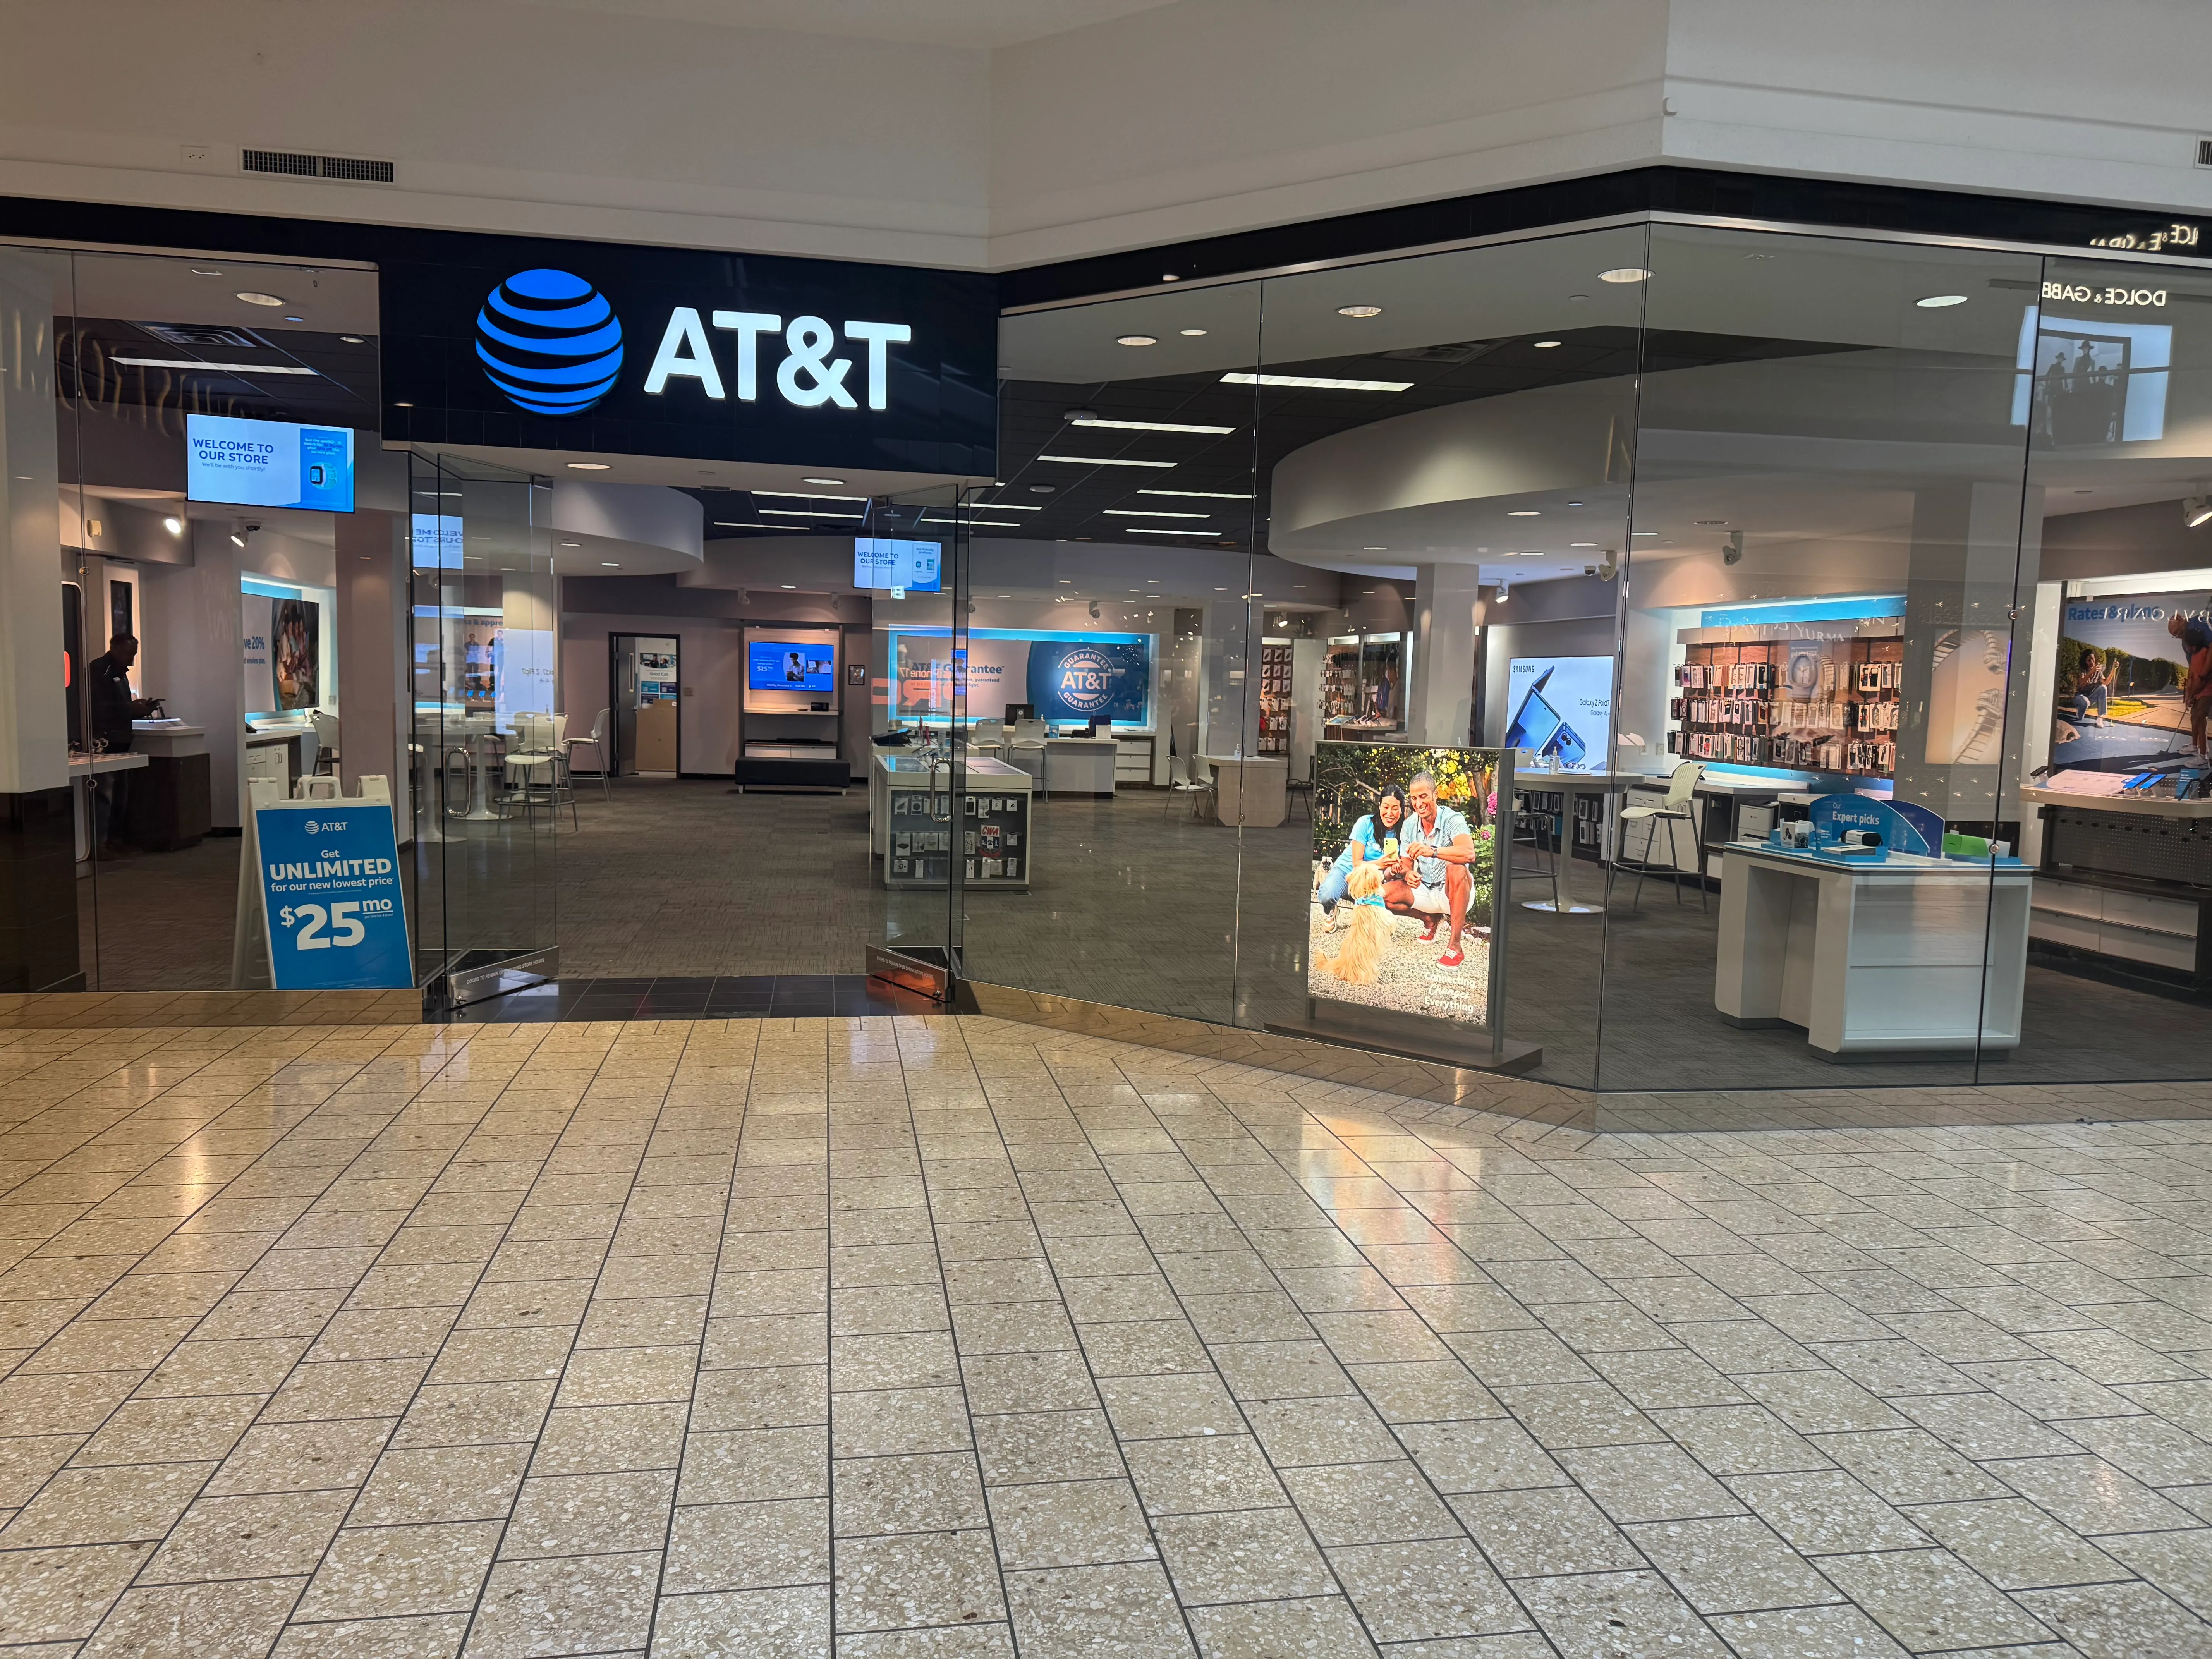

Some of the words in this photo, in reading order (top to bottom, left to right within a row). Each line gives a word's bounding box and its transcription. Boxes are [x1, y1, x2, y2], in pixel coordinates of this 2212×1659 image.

[644, 307, 911, 409] AT&T
[193, 438, 254, 452] WELCOME
[257, 444, 273, 453] TO
[199, 450, 225, 460] OUR
[229, 453, 268, 464] STORE
[2068, 607, 2104, 620] Rates
[2120, 603, 2160, 622] plans
[243, 639, 251, 649] ve
[252, 636, 265, 650] 20%
[1064, 653, 1109, 669] GUARANTEE
[1061, 672, 1111, 689] AT&T
[1064, 692, 1108, 708] GUARANTEE
[1579, 699, 1595, 708] Galaxy
[1590, 710, 1603, 718] Galaxy
[1832, 811, 1857, 824] Expert
[1859, 814, 1879, 826] picks
[321, 822, 348, 831] AT&T
[982, 826, 999, 836] CWA
[321, 850, 340, 859] Get
[270, 858, 391, 880] UNLIMITED
[271, 883, 287, 892] for
[289, 883, 307, 891] our
[309, 881, 330, 890] new
[333, 878, 367, 888] lowest
[280, 901, 365, 950] $25
[362, 898, 392, 911] mo
[467, 976, 479, 984] DOORS
[1424, 972, 1475, 989] Connecting
[1425, 996, 1474, 1014] Everything
